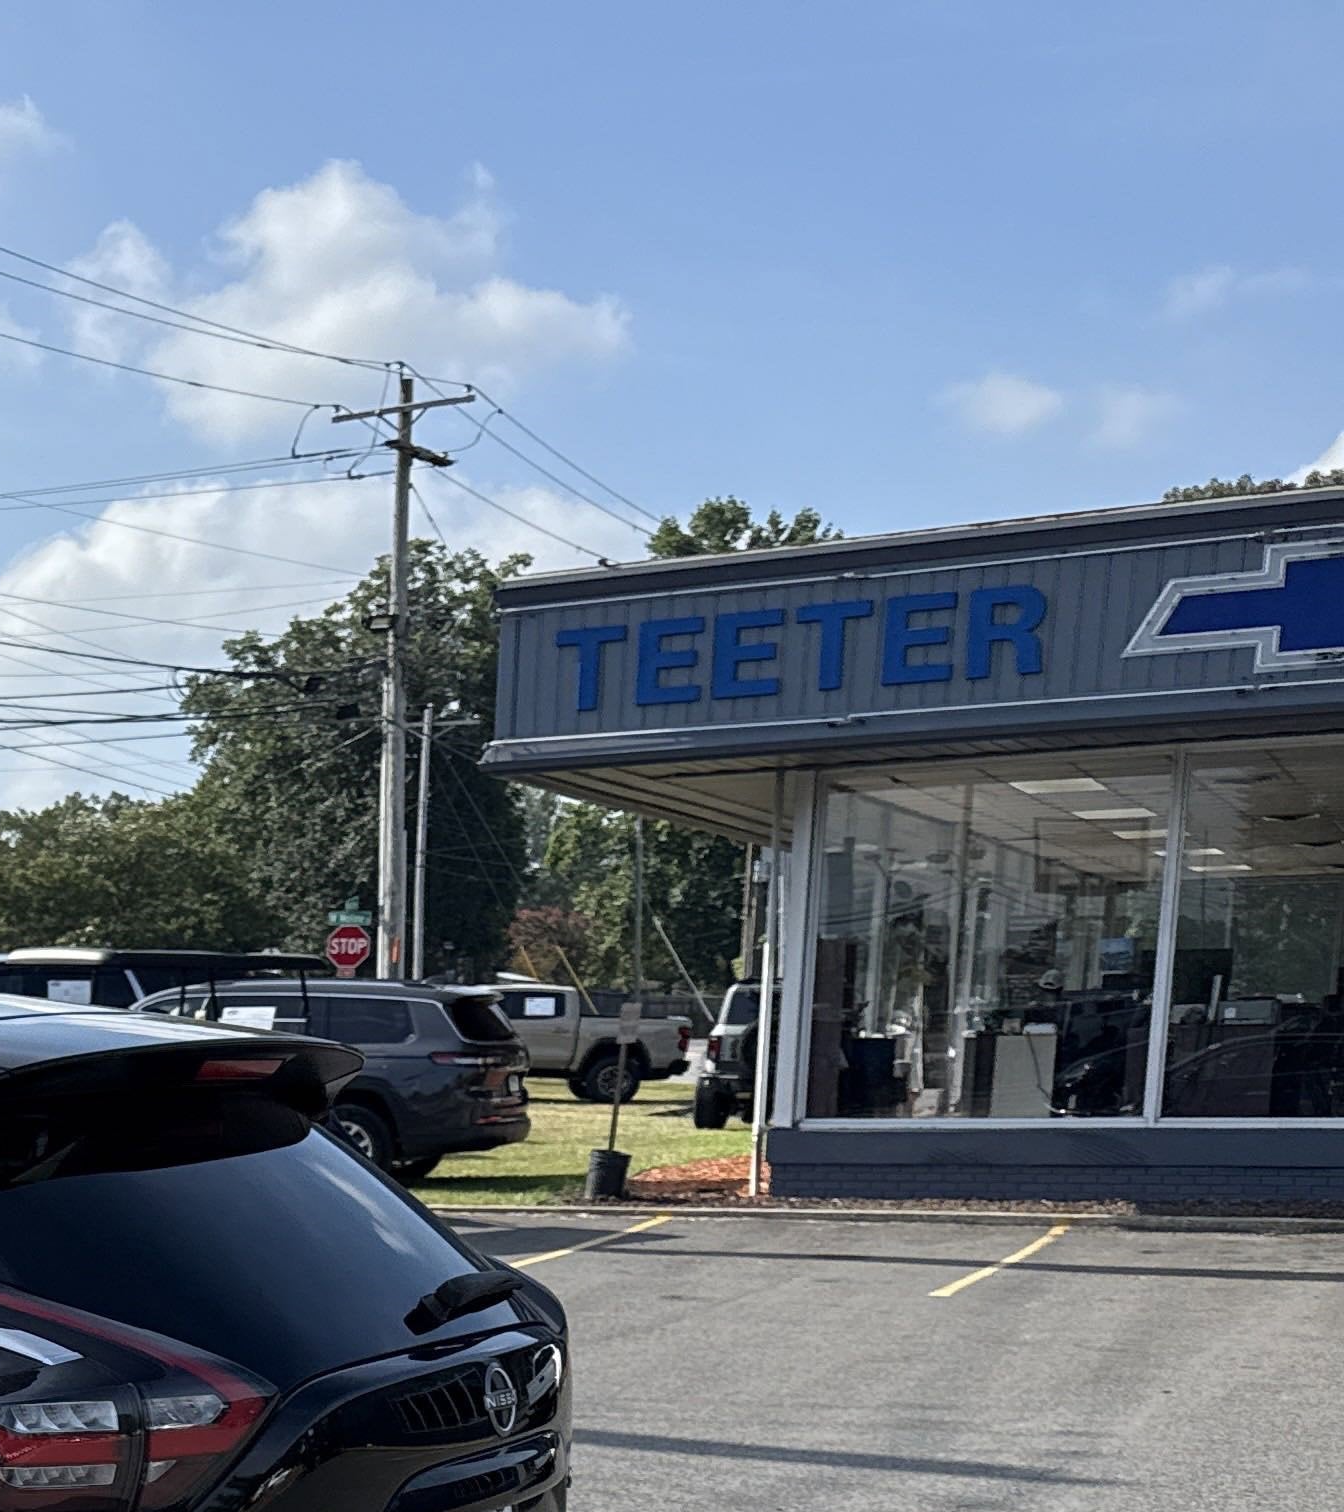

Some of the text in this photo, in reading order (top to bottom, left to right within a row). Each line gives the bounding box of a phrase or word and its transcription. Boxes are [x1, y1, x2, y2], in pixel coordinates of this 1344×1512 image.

[555, 585, 1047, 712] TEETER
[330, 937, 367, 955] STOP
[485, 1389, 517, 1409] NISS
